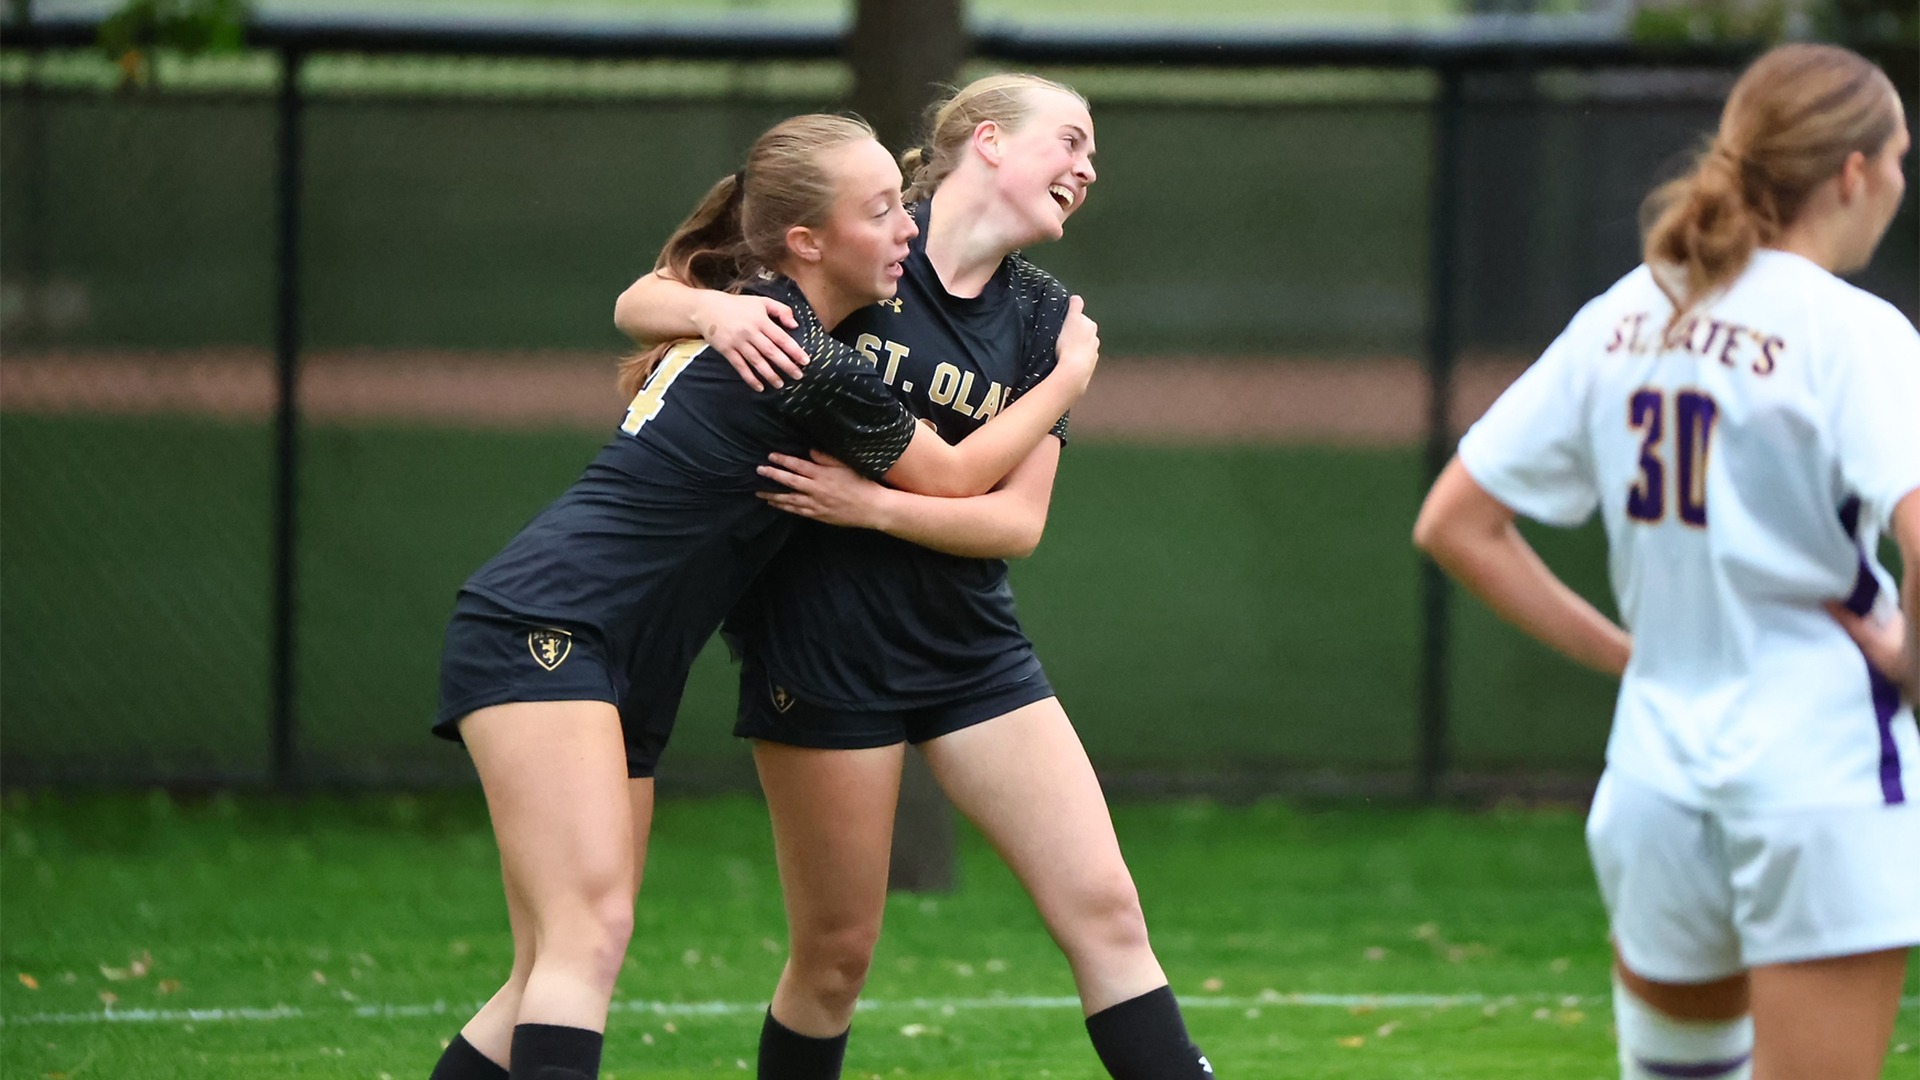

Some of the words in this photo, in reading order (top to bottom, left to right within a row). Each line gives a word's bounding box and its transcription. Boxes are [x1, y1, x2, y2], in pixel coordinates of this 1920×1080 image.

[620, 339, 710, 437] 4
[855, 332, 914, 393] ST.
[928, 361, 1012, 424] OLA
[1626, 386, 1720, 529] 30
